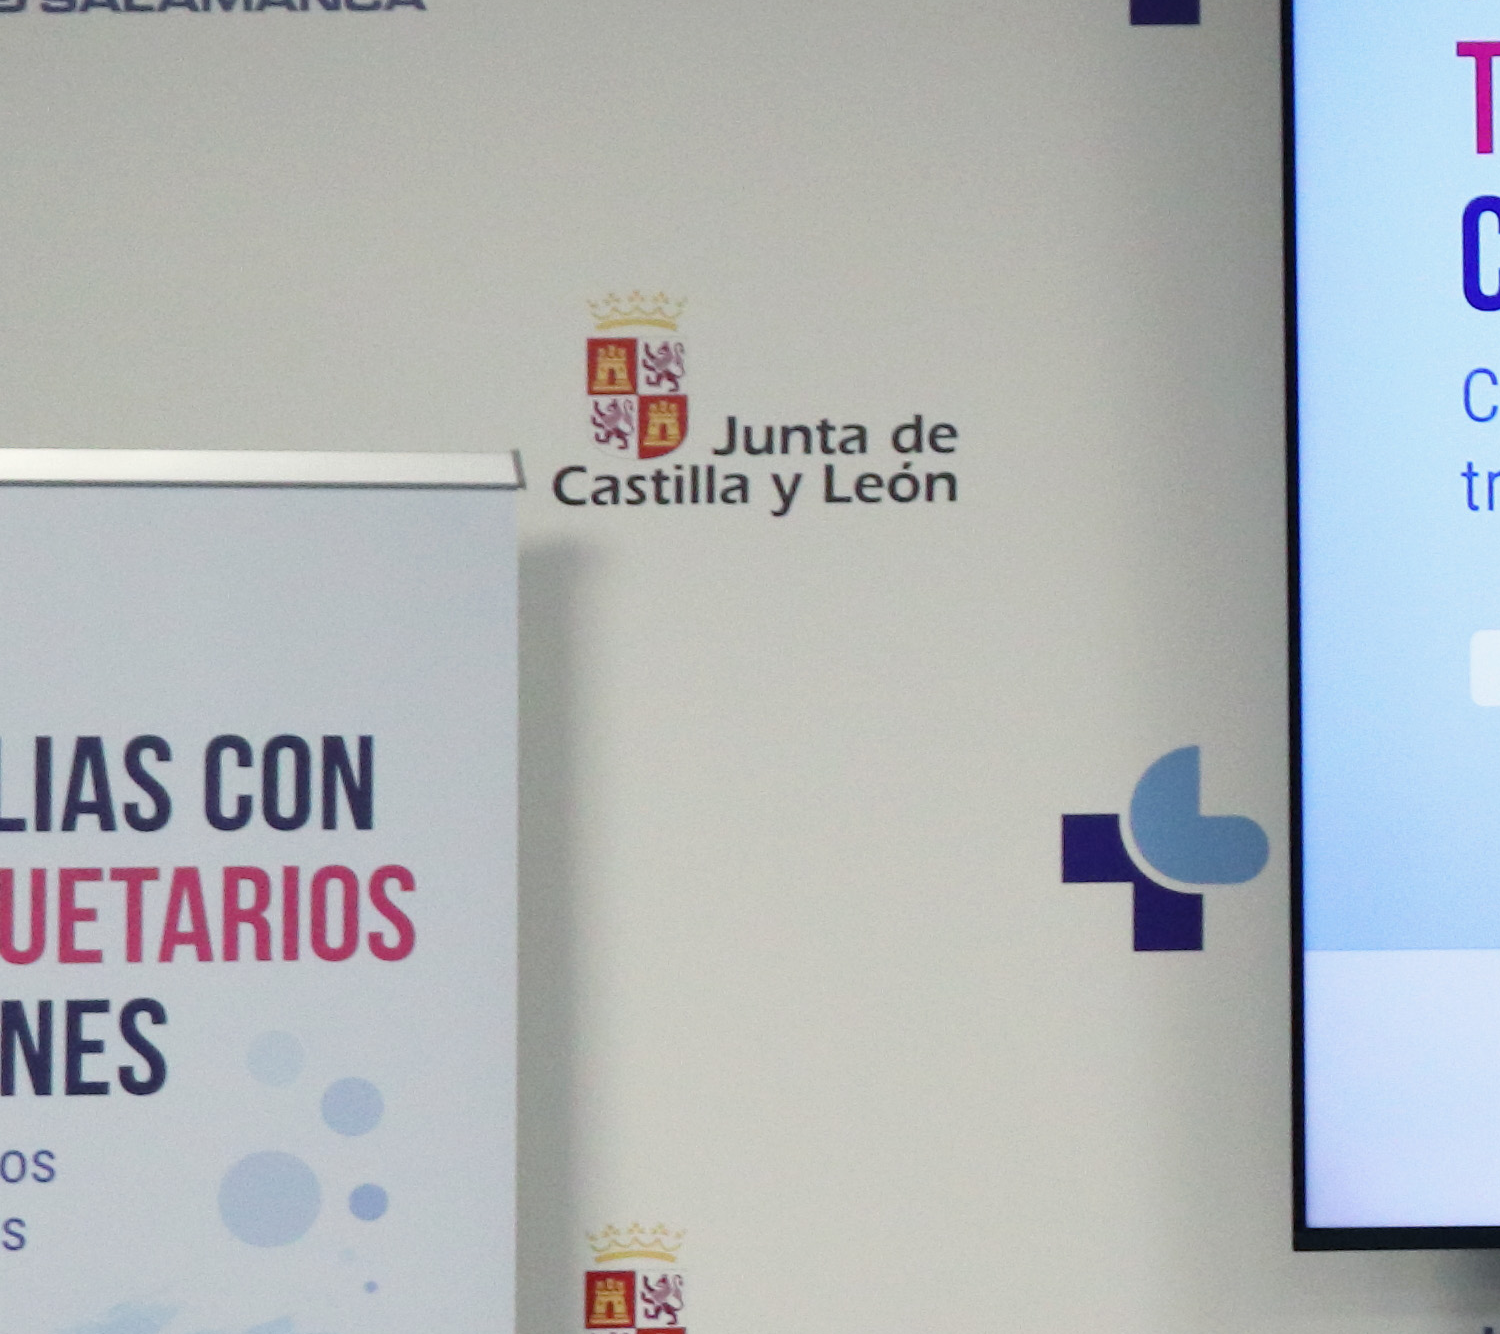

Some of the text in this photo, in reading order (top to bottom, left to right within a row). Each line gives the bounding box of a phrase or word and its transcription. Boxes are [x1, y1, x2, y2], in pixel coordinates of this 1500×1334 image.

[713, 415, 957, 456] Junta de
[553, 462, 956, 517] Castilla y León
[205, 735, 373, 831] CON
